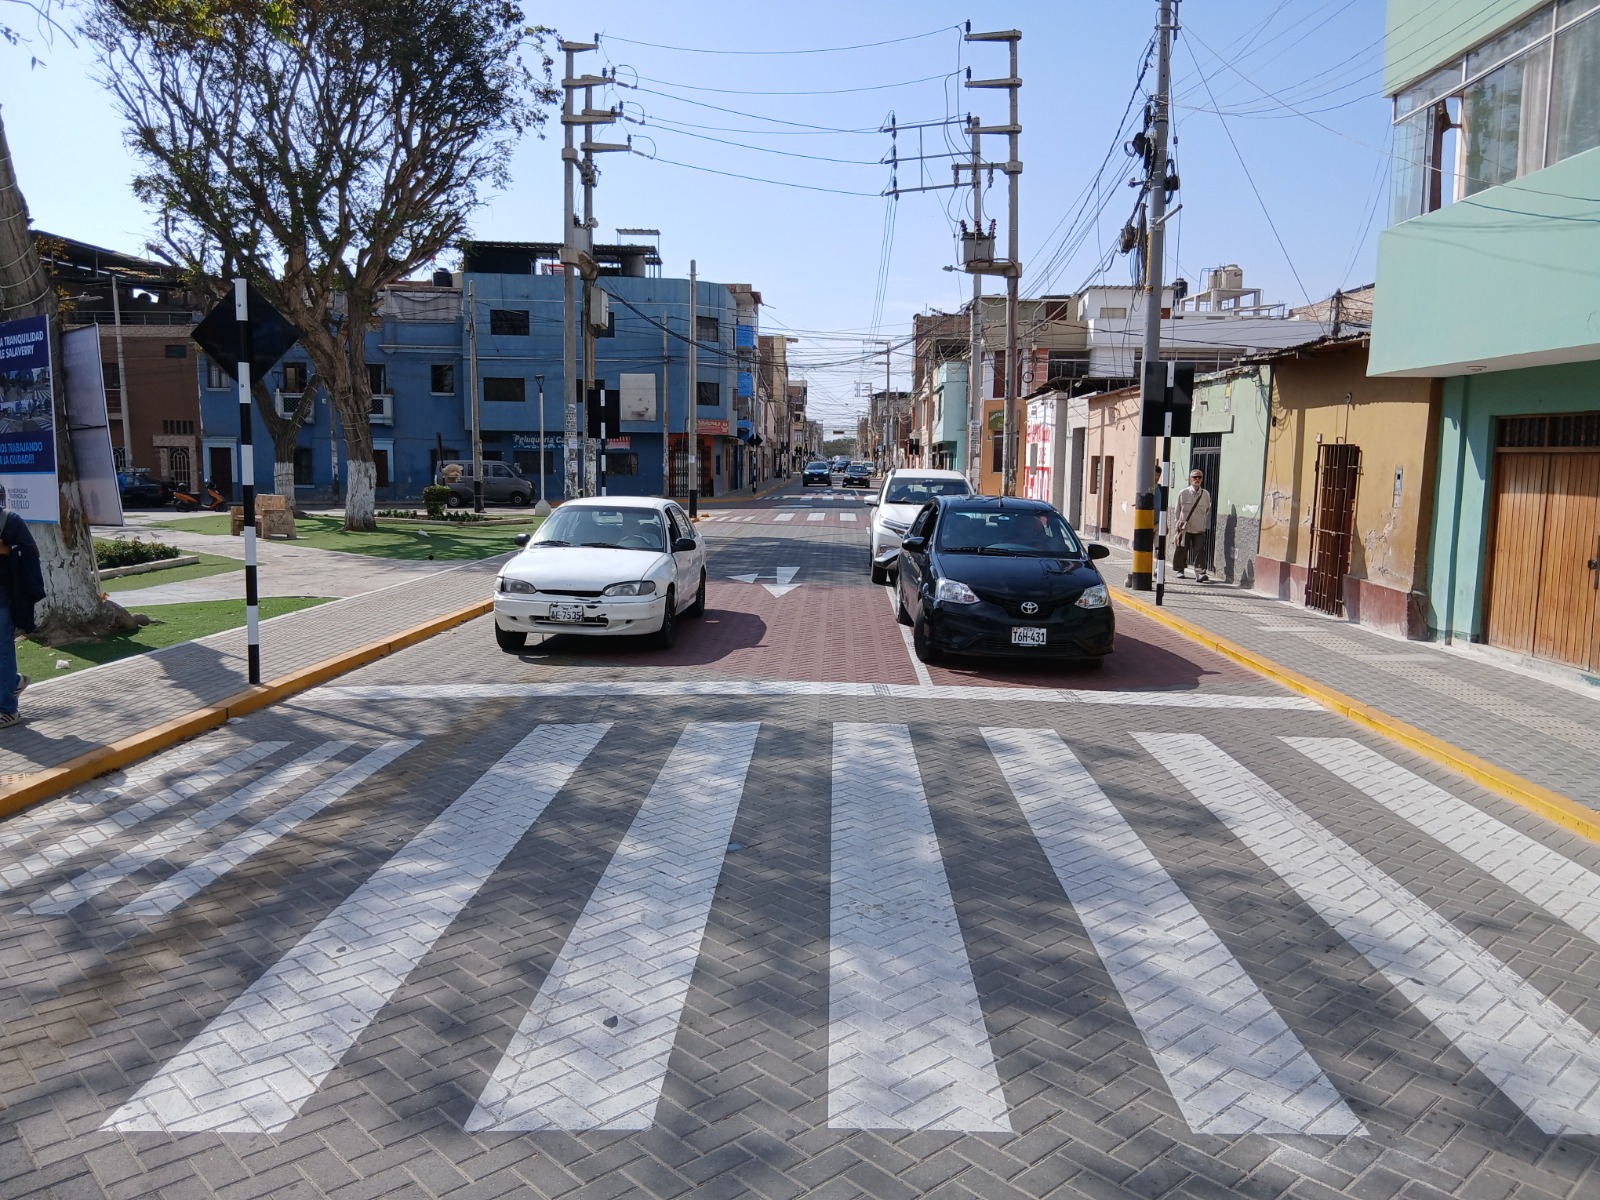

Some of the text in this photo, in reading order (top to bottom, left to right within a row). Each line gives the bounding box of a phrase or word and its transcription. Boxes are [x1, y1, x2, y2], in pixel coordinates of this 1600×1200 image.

[4, 331, 43, 346] TRANQUILIDAD
[6, 345, 34, 358] SALAVERRY
[8, 442, 43, 452] TRABAJANDO
[1013, 631, 1045, 643] T6H-431
